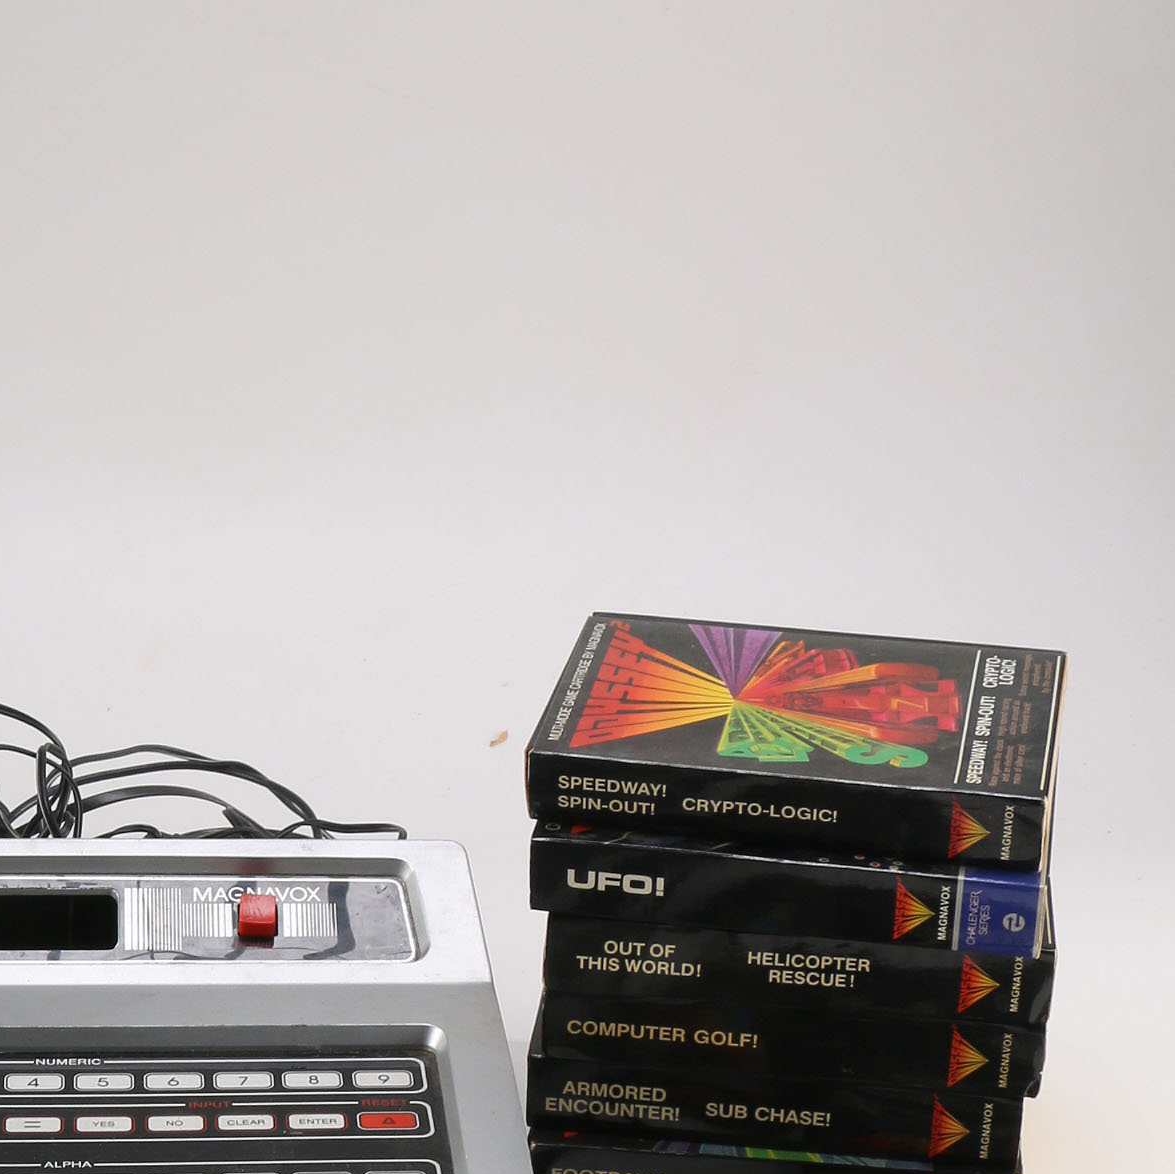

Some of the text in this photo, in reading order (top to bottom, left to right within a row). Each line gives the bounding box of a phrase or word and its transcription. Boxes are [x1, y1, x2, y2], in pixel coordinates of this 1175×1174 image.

[982, 655, 1001, 688] CRYPTO-
[998, 659, 1017, 686] LOGIC!
[965, 696, 996, 785] SPEEDWAY! SPIN-OUT!
[558, 775, 667, 797] SPEEDWAY!
[557, 795, 655, 815] SPIN-OUT!
[682, 797, 838, 823] CRYPTO-LOGIC!
[1000, 805, 1016, 861] MAGNAVOX
[567, 869, 665, 897] UFO!
[937, 885, 952, 941] MAGNAVOX
[966, 889, 983, 946] CHALLENGER
[978, 904, 991, 936] SERIES
[604, 940, 676, 959] OUT OF
[747, 951, 871, 973] HELICOPTER
[576, 955, 702, 978] THIS WORLD!
[768, 969, 855, 988] RESCUE!
[1009, 956, 1024, 1013] MAGNAVOX
[567, 1019, 758, 1048] COMPUTER GOLF!
[35, 1058, 102, 1066] NUMERIC
[998, 1033, 1013, 1089] MAGNAVOX
[26, 1077, 40, 1088] 4
[97, 1077, 110, 1088] 5
[167, 1076, 180, 1087] 6
[238, 1076, 249, 1086] 7
[308, 1075, 320, 1085] 8
[377, 1074, 390, 1084] 9
[562, 1080, 667, 1102] ARMORED
[189, 1101, 230, 1109] INPUT
[362, 1099, 407, 1107] RESET
[544, 1097, 680, 1121] ENCOUNTER!
[705, 1102, 832, 1127] SUB CHASE!
[979, 1103, 994, 1160] MAGNAVOX
[44, 1161, 92, 1169] ALPHA
